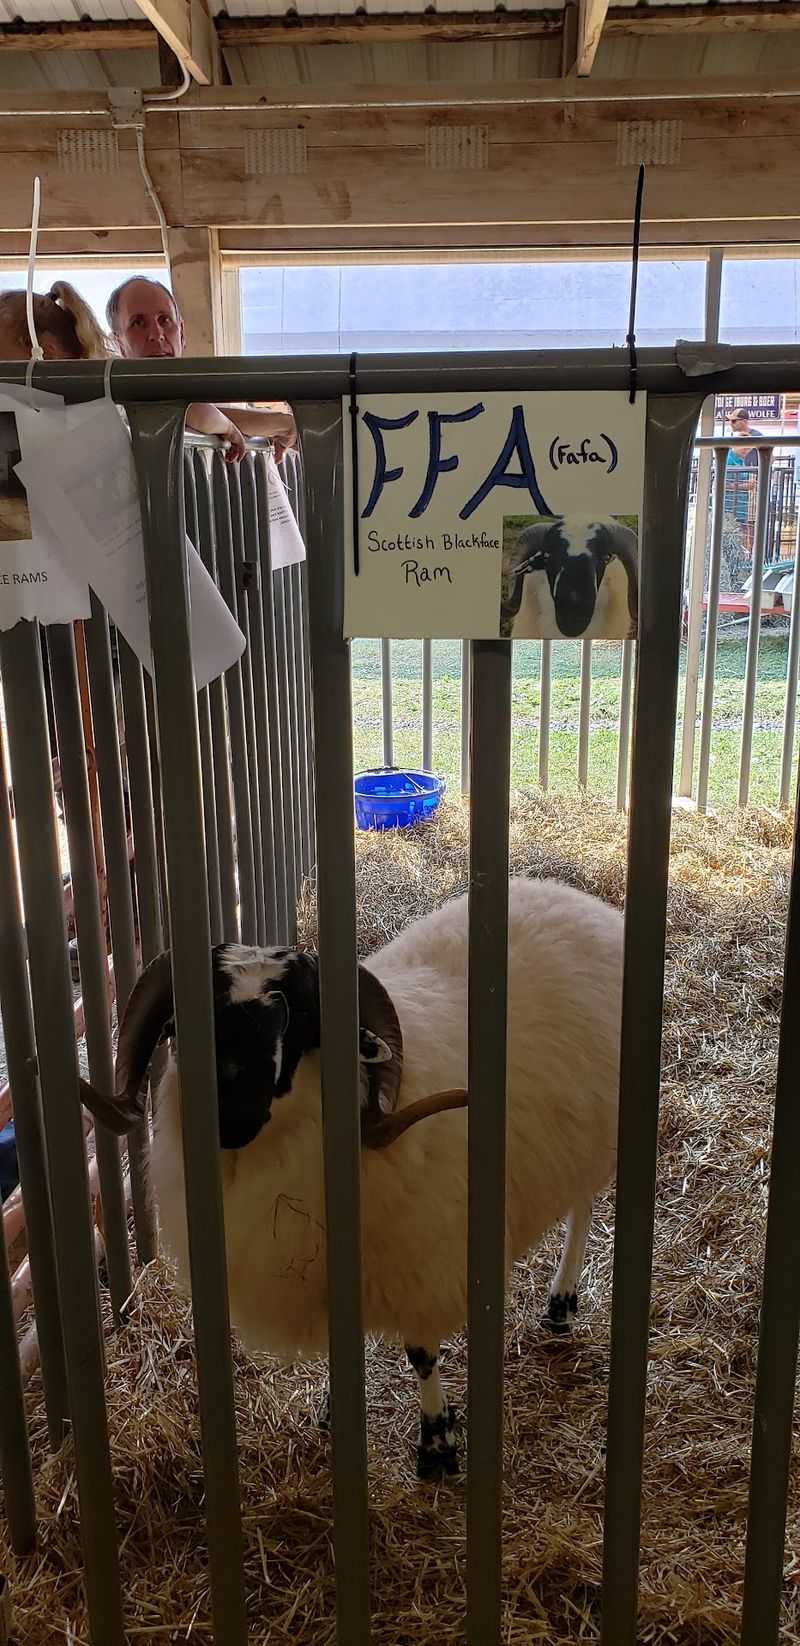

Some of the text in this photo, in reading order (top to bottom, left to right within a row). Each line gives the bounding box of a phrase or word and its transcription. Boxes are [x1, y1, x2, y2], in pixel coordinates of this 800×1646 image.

[759, 396, 775, 407] BOER
[747, 410, 777, 418] WOLFE
[361, 402, 618, 521] FFA (Fafa)
[367, 530, 501, 552] Scottish Blackface
[12, 571, 48, 584] RAMS
[400, 560, 452, 587] Ram
